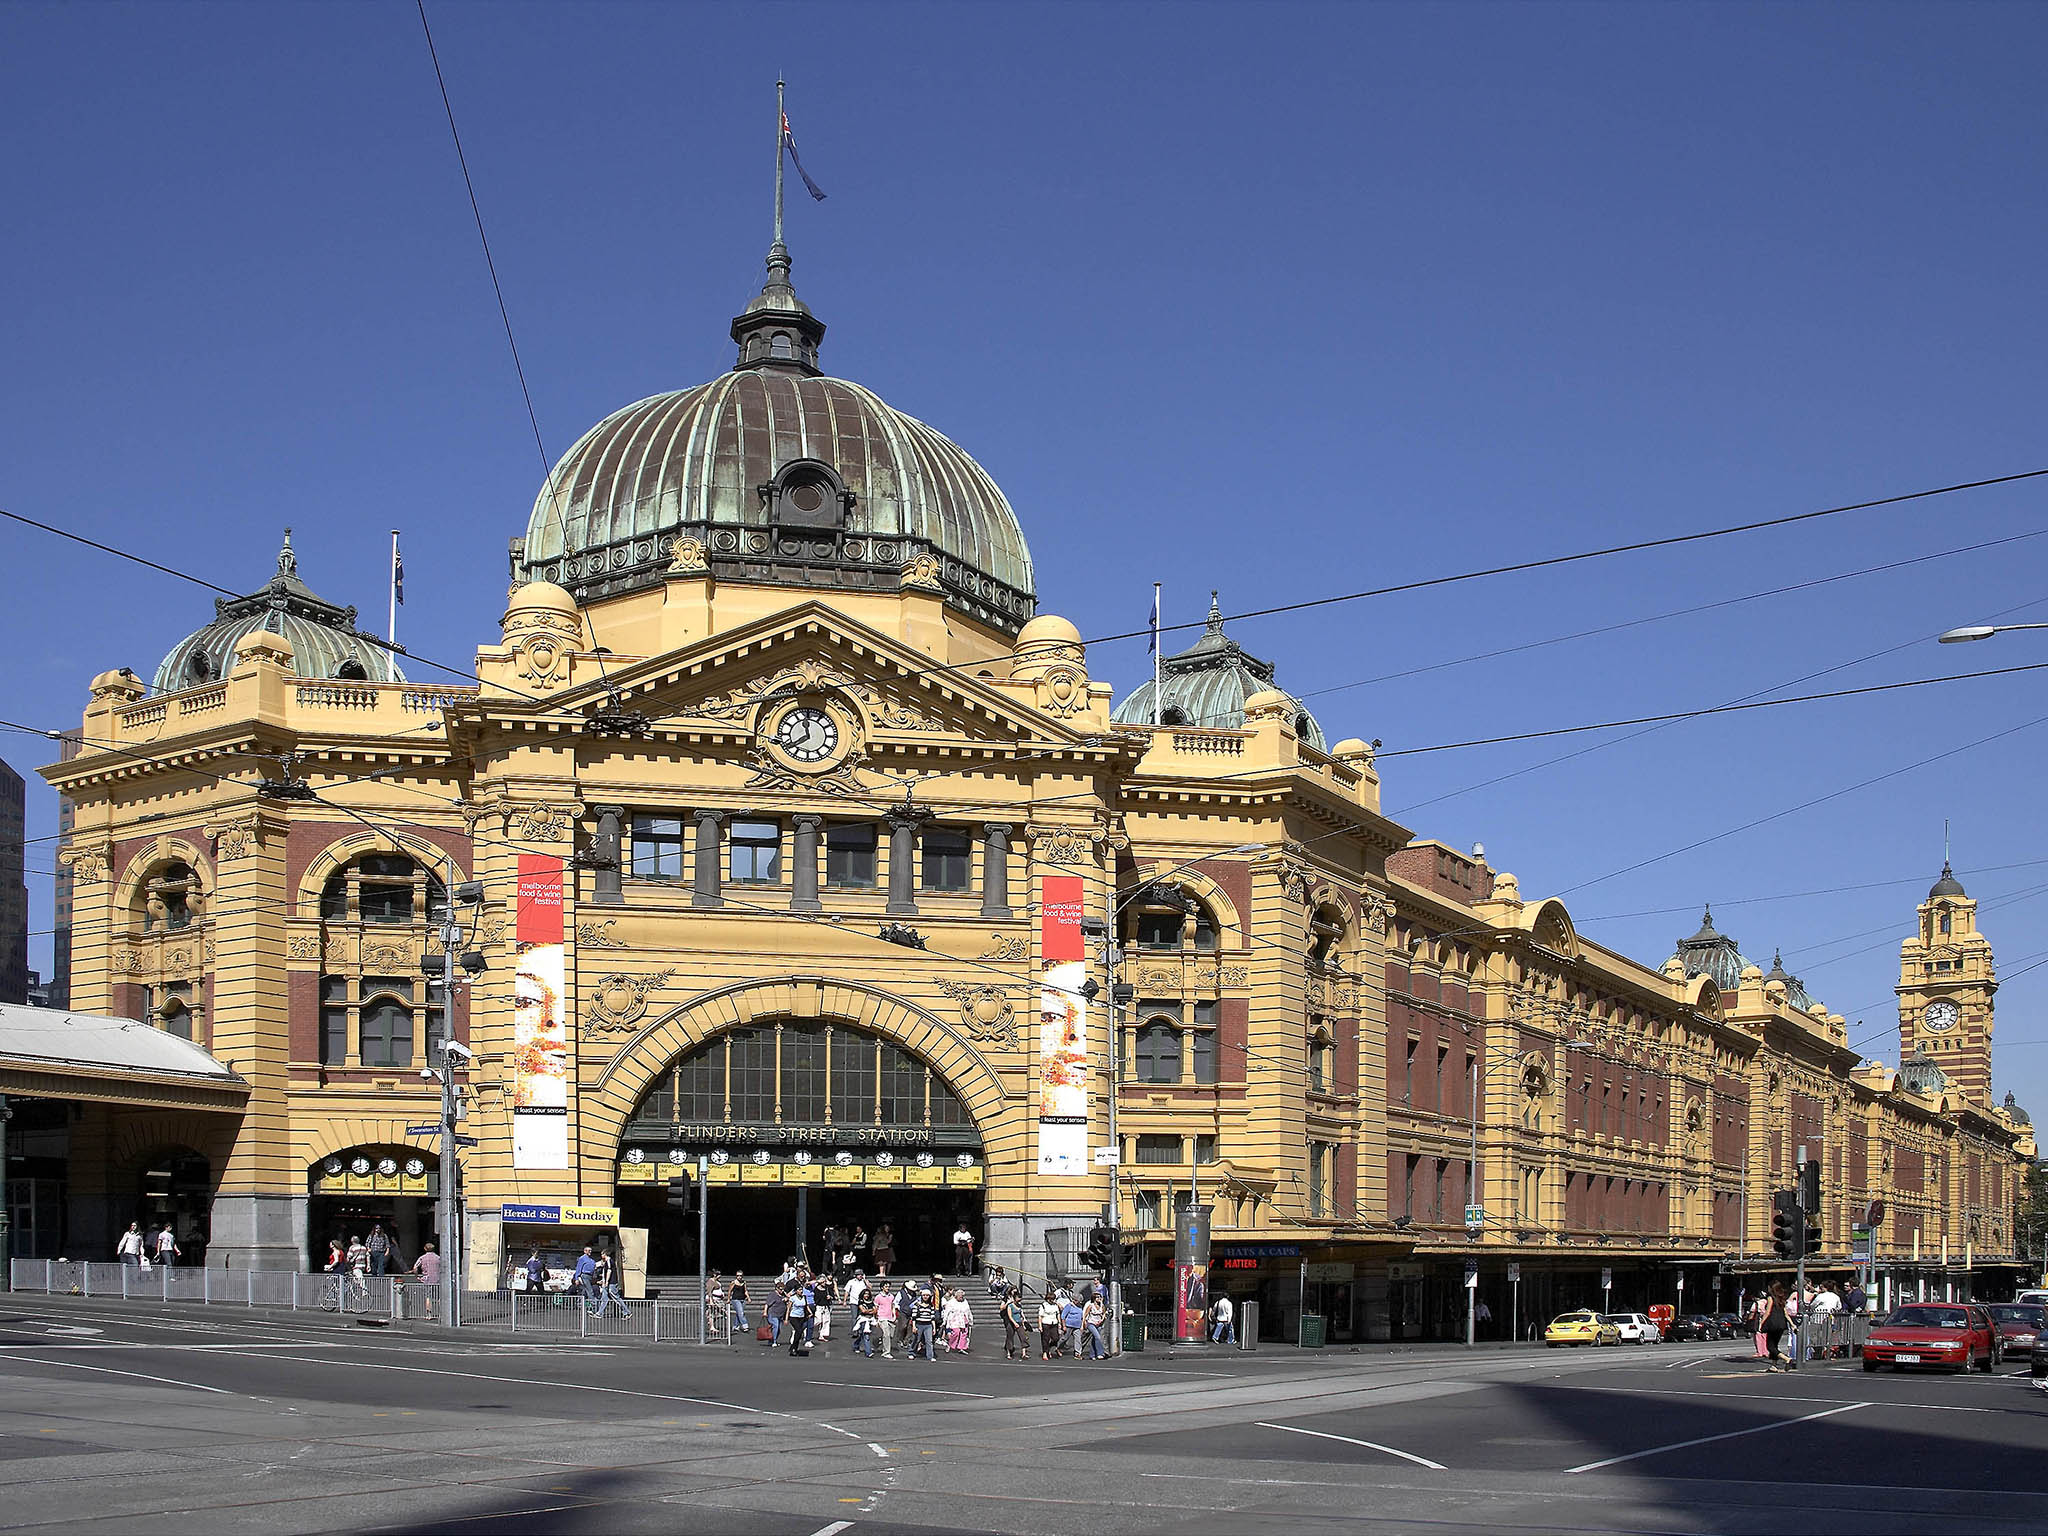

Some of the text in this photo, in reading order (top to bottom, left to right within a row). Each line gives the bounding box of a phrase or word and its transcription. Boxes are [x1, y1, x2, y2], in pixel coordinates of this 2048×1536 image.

[519, 889, 535, 897] food
[677, 1125, 930, 1141] FLINDERS STREET STATION
[503, 1208, 559, 1219] Herald Sun
[565, 1209, 614, 1223] Sunday
[1226, 1247, 1296, 1257] HATS & CAPS
[1223, 1259, 1257, 1269] HATTERS
